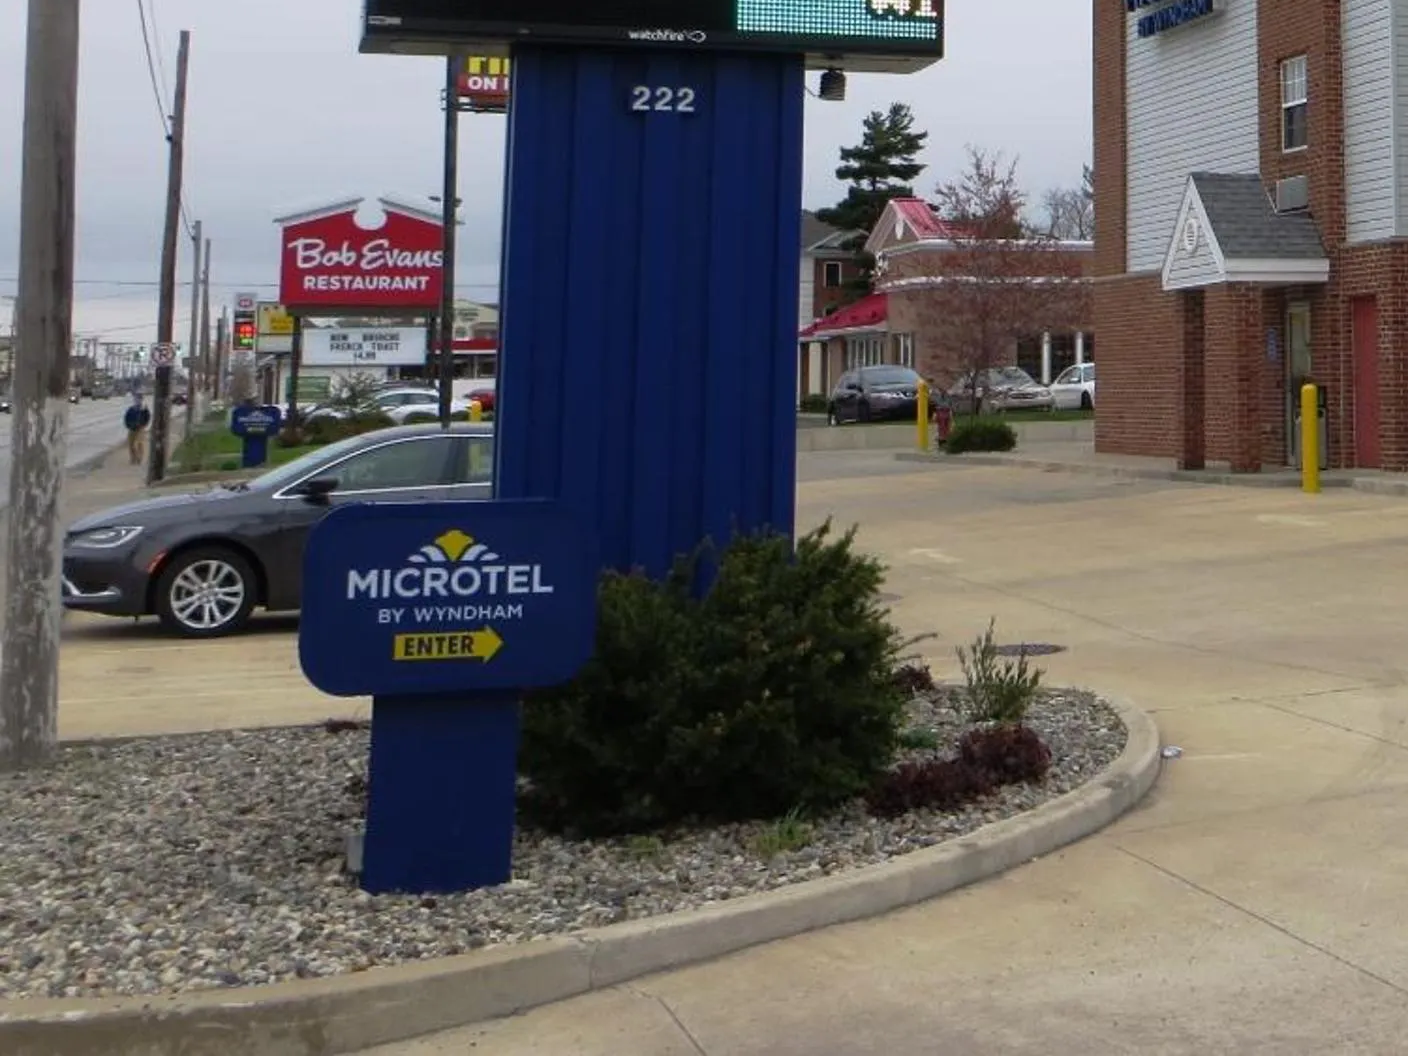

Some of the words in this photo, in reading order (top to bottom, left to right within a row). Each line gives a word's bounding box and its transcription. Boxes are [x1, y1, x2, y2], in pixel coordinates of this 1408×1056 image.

[467, 75, 498, 91] ON
[632, 85, 696, 113] 222
[287, 237, 357, 269] Bob
[359, 238, 444, 271] Evans
[303, 275, 431, 292] RESTAURANT
[347, 564, 554, 600] MICROTEL
[378, 608, 405, 624] BY
[414, 604, 523, 623] WYNDHAM
[403, 635, 475, 657] ENTER
